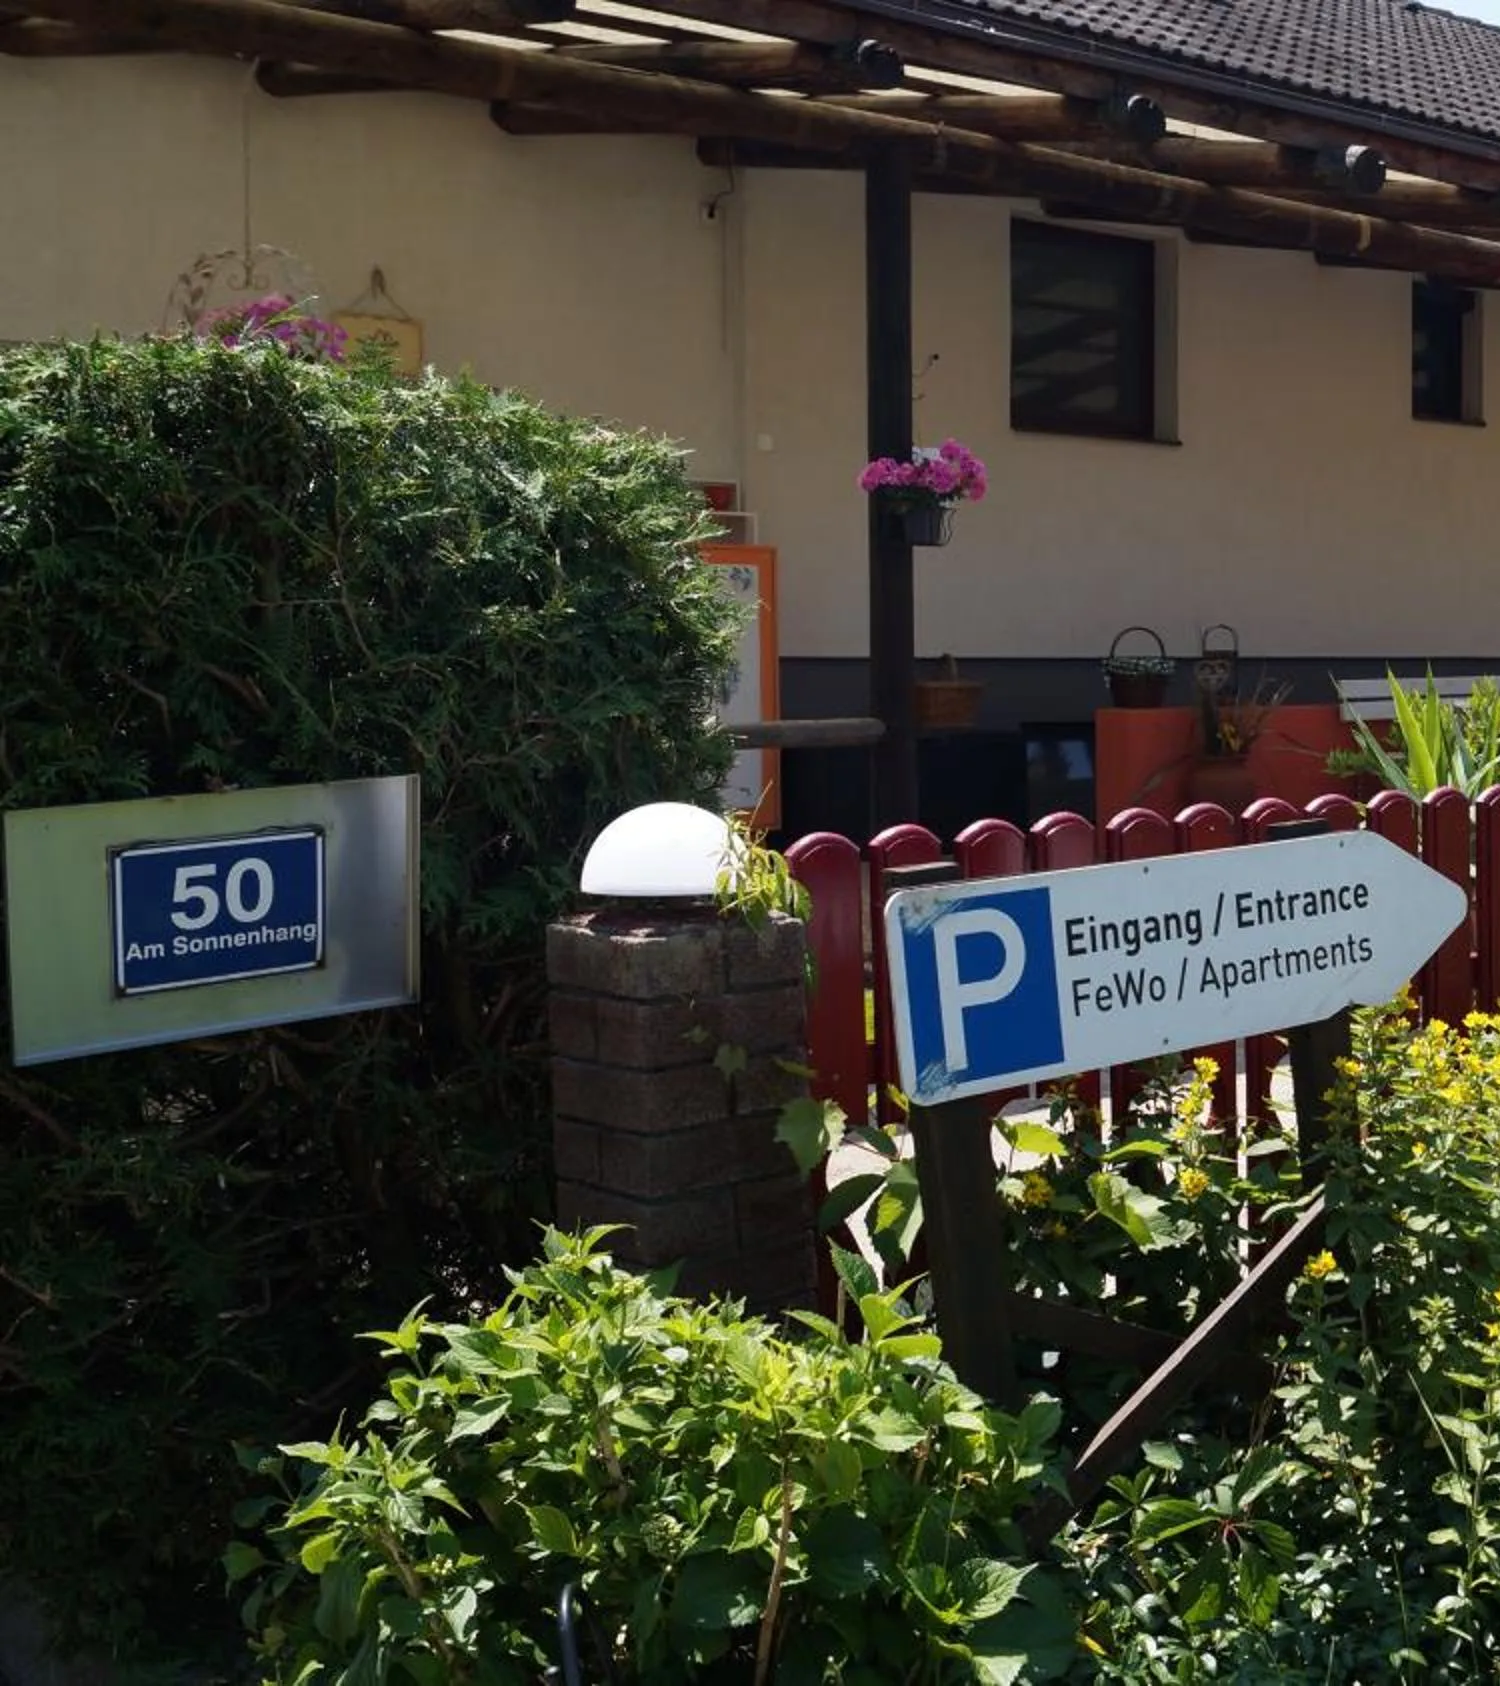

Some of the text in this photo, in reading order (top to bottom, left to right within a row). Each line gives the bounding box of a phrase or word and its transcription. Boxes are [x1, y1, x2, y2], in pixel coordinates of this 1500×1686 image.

[171, 858, 274, 930] 50
[1065, 908, 1201, 957] Eingang
[1235, 881, 1370, 929] Entrance
[126, 922, 317, 961] Am Sonnenhang
[1072, 968, 1166, 1017] FeWo
[1199, 934, 1374, 998] Apartments
[933, 907, 1026, 1073] P
